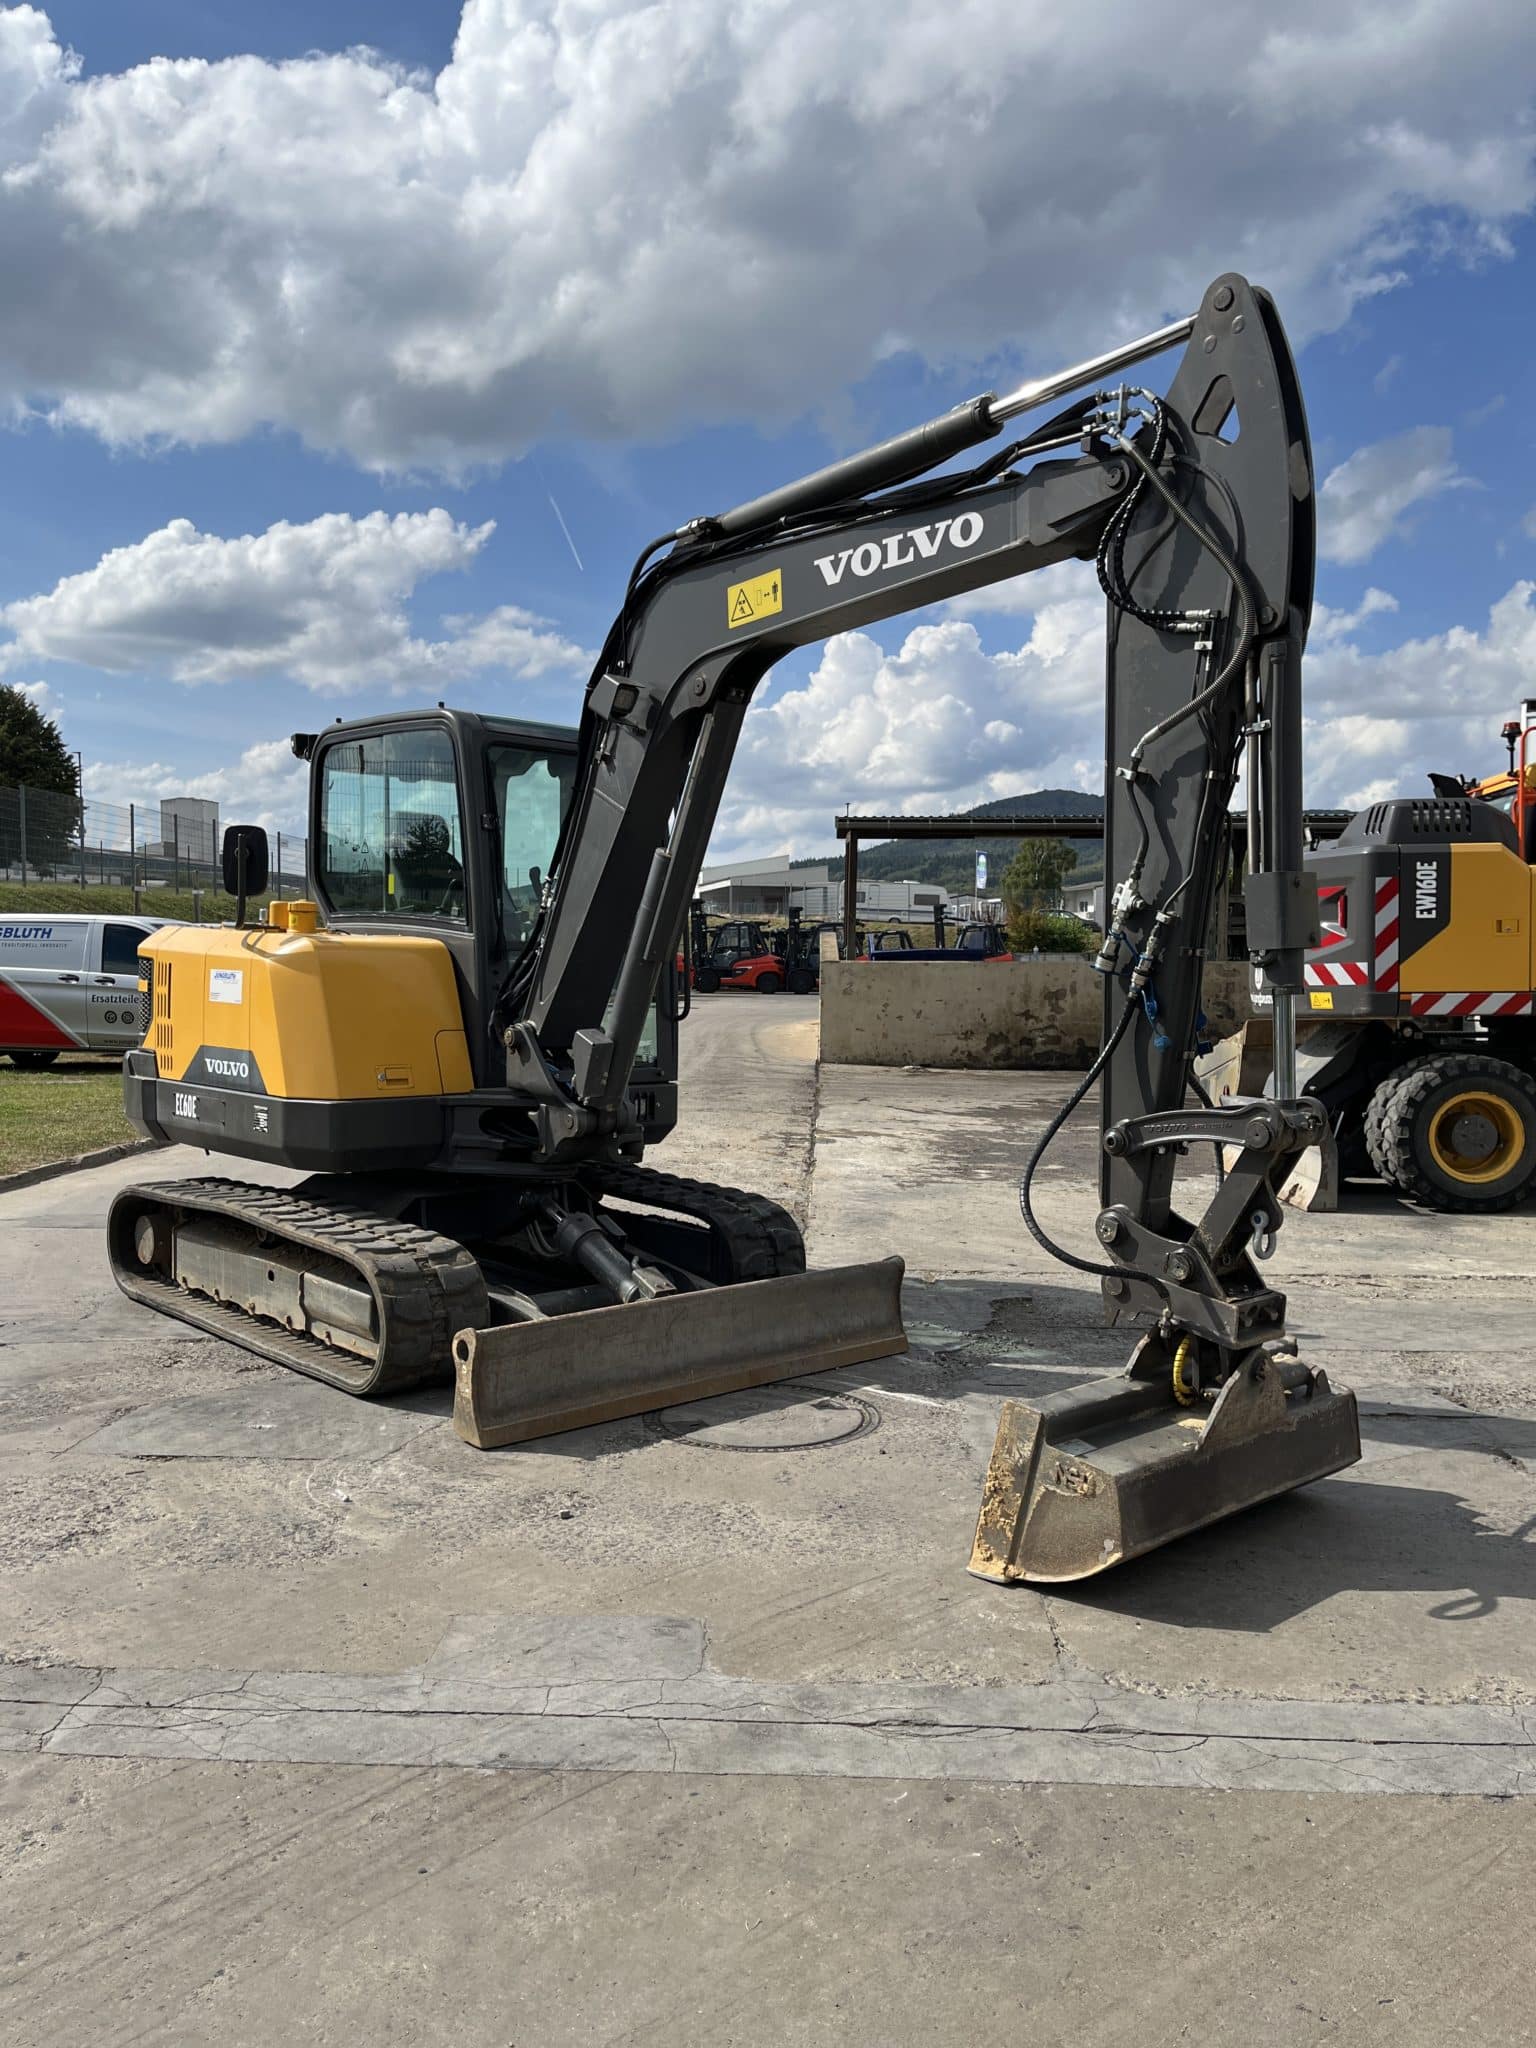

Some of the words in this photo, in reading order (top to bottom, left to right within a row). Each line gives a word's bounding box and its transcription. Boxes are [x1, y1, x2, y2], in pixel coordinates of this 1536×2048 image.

[814, 511, 984, 586] VOLVO
[1415, 861, 1437, 919] EW160E
[91, 994, 140, 1004] Ersatzteile
[205, 1057, 249, 1078] VOLVO
[175, 1092, 197, 1118] EC60E
